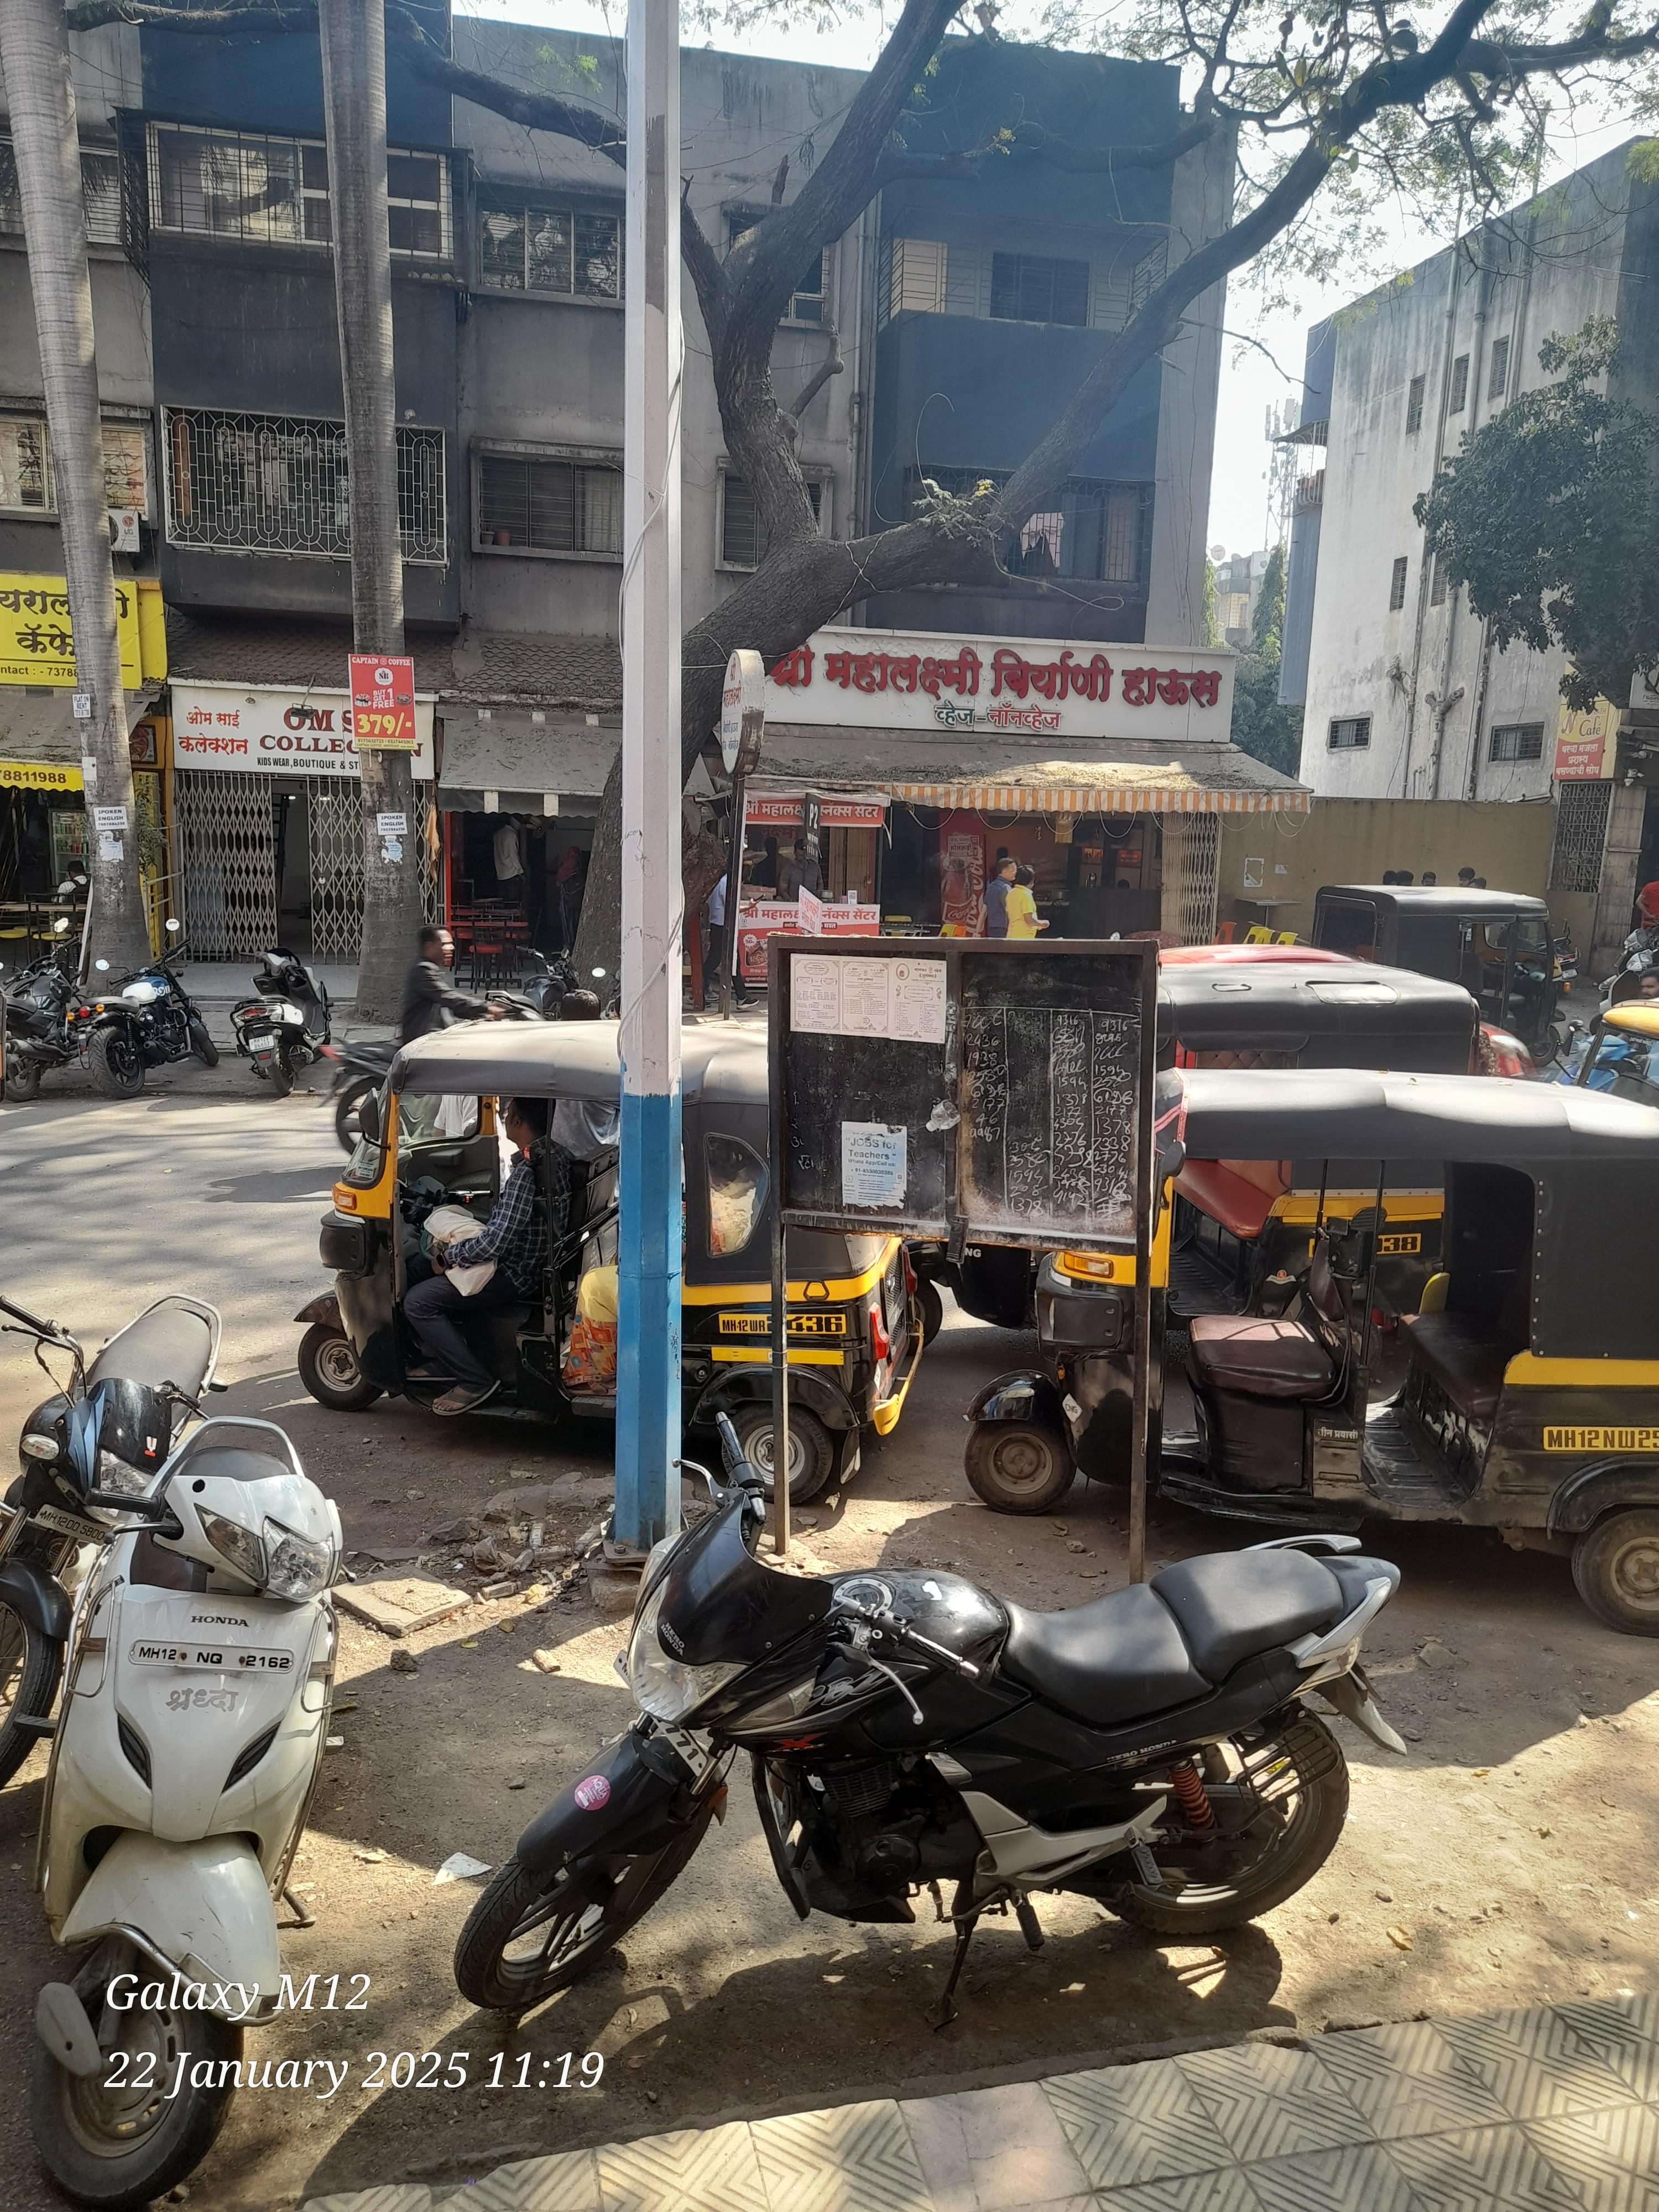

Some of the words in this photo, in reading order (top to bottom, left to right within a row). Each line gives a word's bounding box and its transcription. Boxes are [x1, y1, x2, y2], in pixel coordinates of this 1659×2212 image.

[825, 647, 979, 698] महालक्ष्मी
[1122, 666, 1222, 708] हाऊस
[373, 700, 395, 709] FREE
[186, 706, 212, 726] ओम
[216, 709, 240, 729] साई
[283, 708, 336, 732] OM
[357, 712, 413, 737] 379/-
[178, 733, 249, 755] कलेक्शन
[257, 757, 272, 766] KIDS
[293, 759, 336, 769] BOUTIQUE
[340, 761, 346, 769] &
[0, 770, 66, 784] 8811988
[809, 803, 818, 830] P2
[1057, 1015, 1079, 1025] 9316
[1101, 1020, 1129, 1032] 9316
[965, 1033, 999, 1047] 2436
[968, 1051, 997, 1067] 1938
[1095, 1105, 1126, 1116] 2177
[1097, 1117, 1131, 1135] 1378
[1092, 1135, 1131, 1151] 7338
[848, 1149, 890, 1160] Teachers
[1011, 1197, 1044, 1216] 1378
[964, 1248, 982, 1258] NG
[766, 1315, 843, 1332] 436
[191, 1615, 249, 1627] HONDA
[660, 1623, 684, 1656] HONDA
[665, 1621, 685, 1648] HERO
[138, 1646, 177, 1660] MH12
[196, 1652, 223, 1665] NQ
[246, 1655, 290, 1669] 2162
